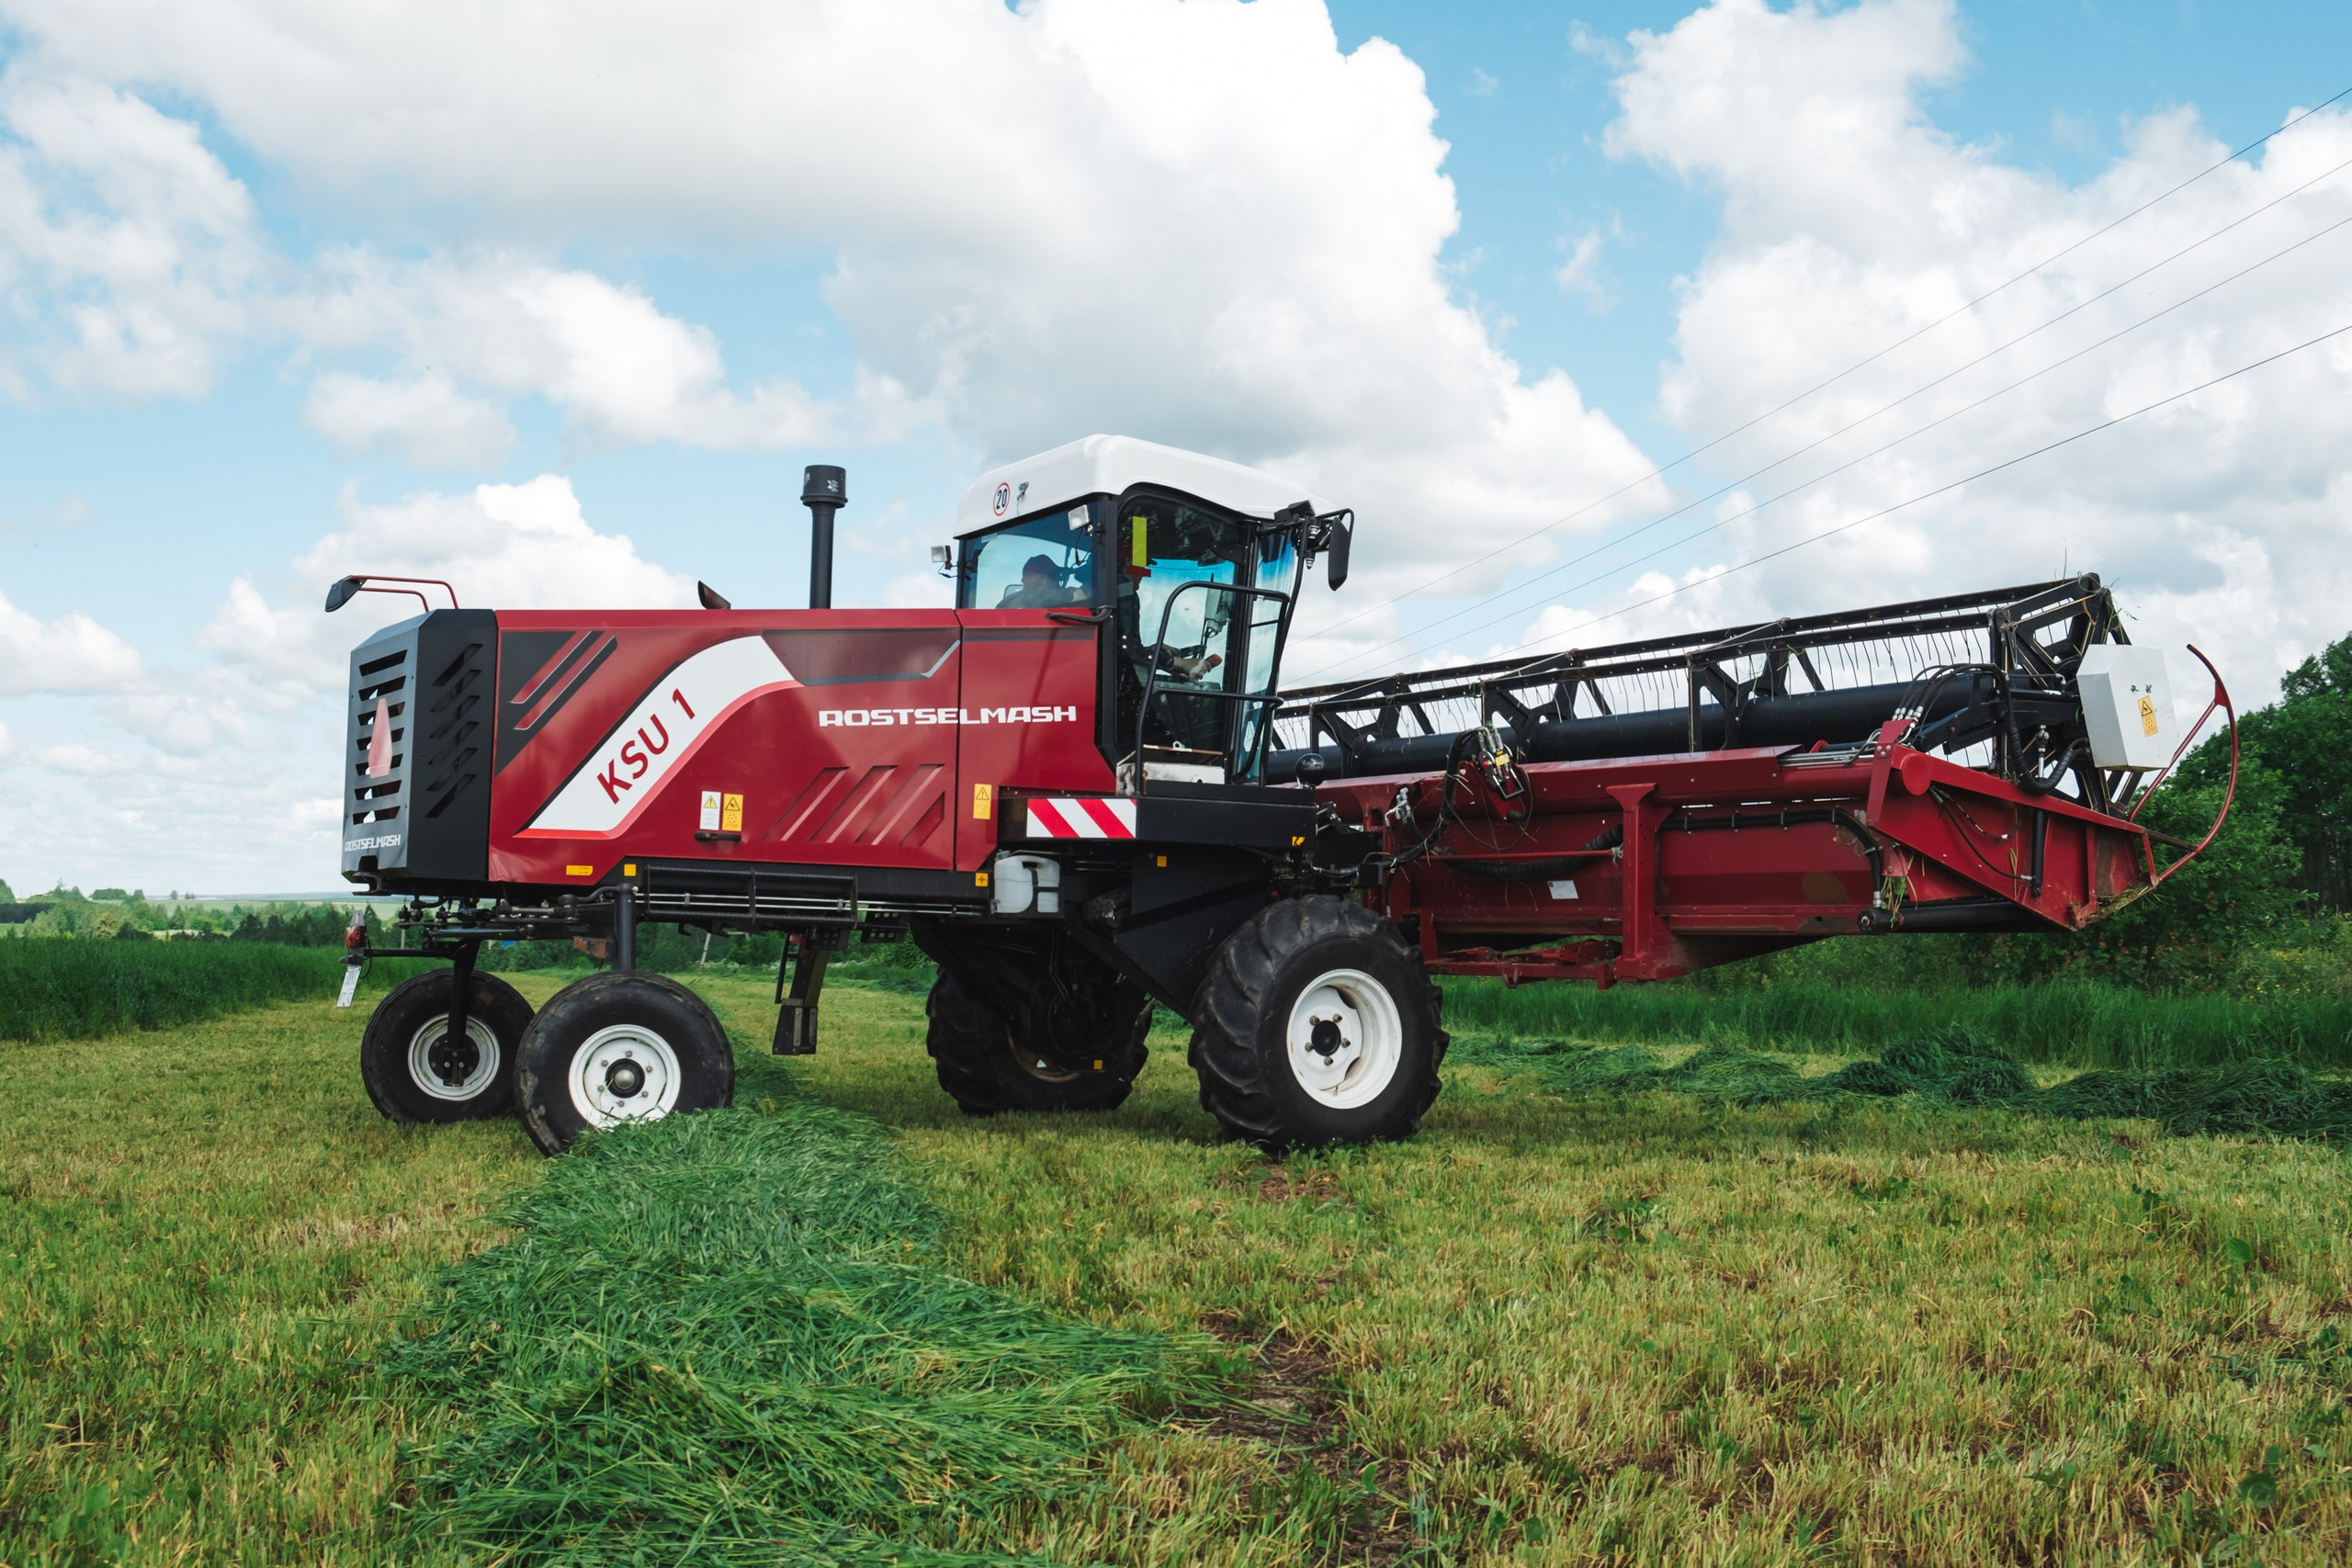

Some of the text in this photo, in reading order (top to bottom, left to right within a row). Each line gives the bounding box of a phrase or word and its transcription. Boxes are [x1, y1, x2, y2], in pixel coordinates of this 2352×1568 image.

[996, 488, 1008, 510] 20
[819, 705, 1077, 728] ROSTSELMASH
[596, 688, 695, 806] KSU 1
[344, 833, 401, 852] ROSTSELMASH
